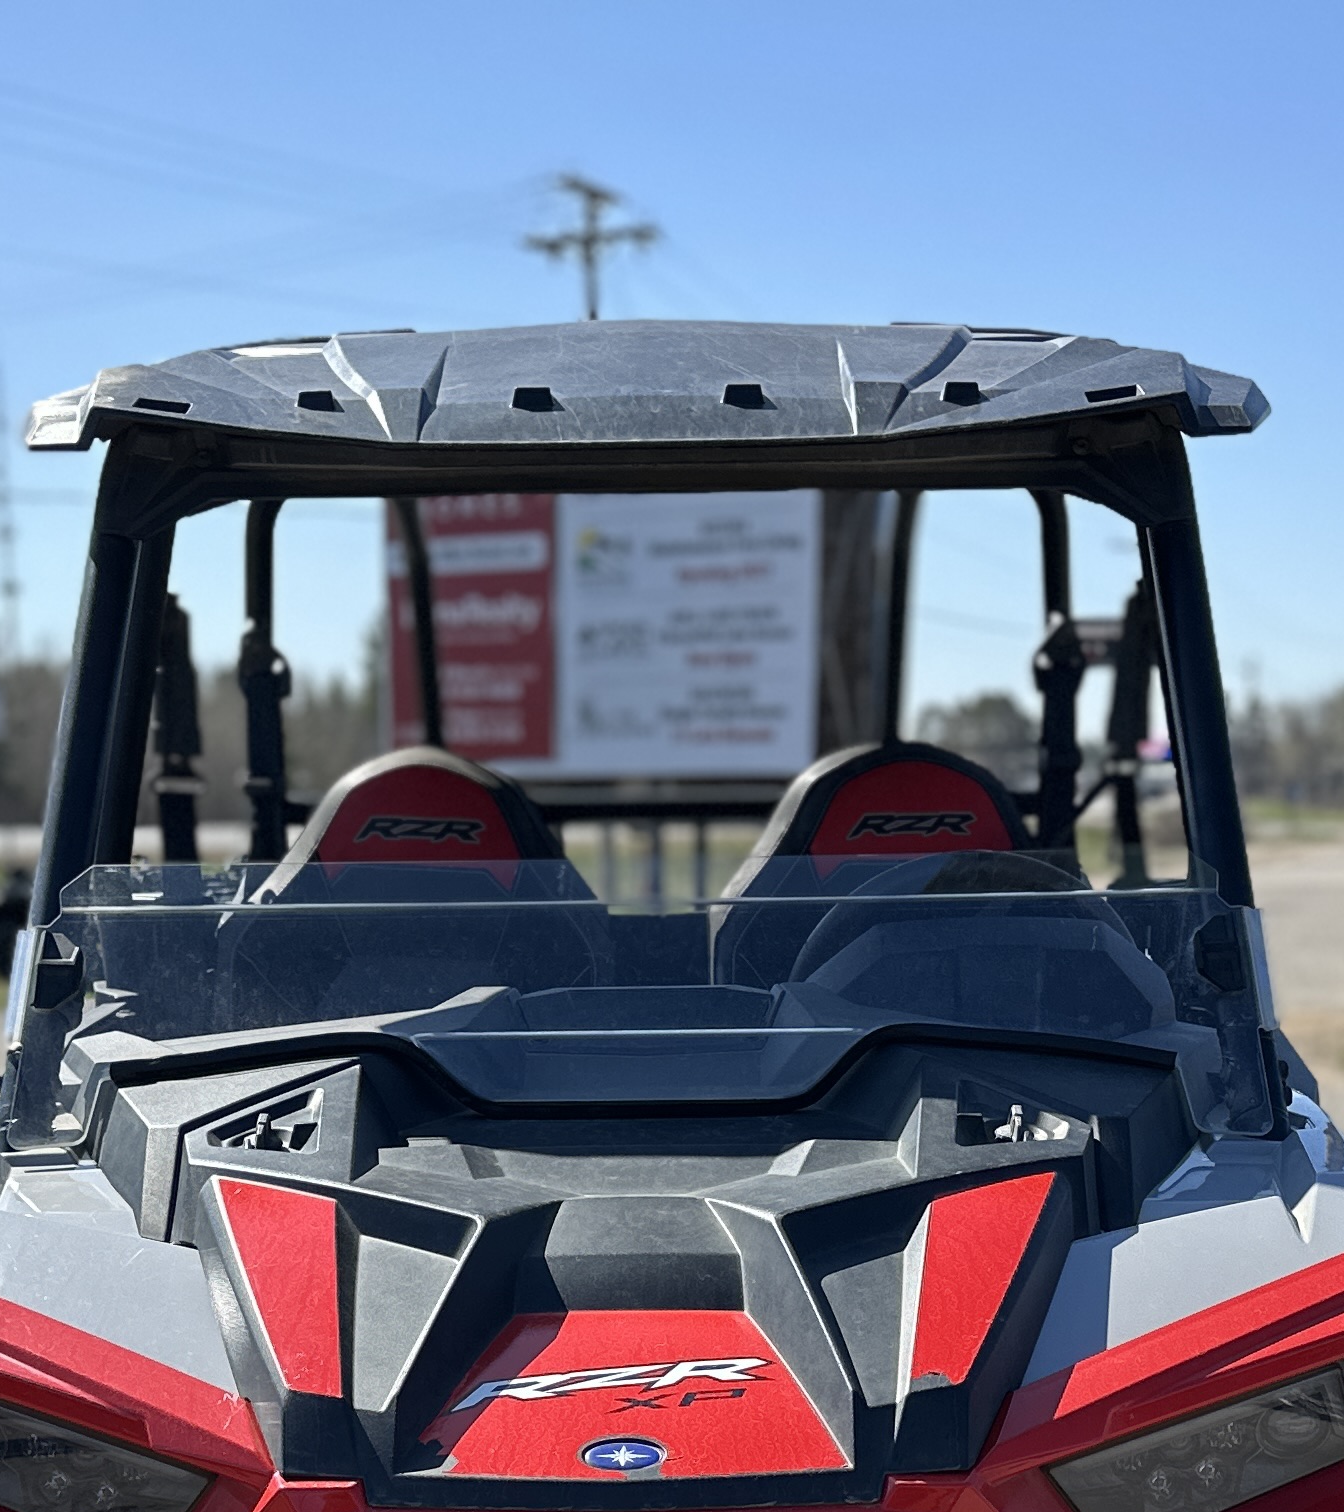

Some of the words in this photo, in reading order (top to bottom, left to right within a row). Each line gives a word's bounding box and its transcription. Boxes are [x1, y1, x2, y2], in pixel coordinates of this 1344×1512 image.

[354, 815, 485, 844] RZR
[846, 811, 977, 841] RZR
[449, 1357, 774, 1413] RZR
[604, 1387, 748, 1414] XP
